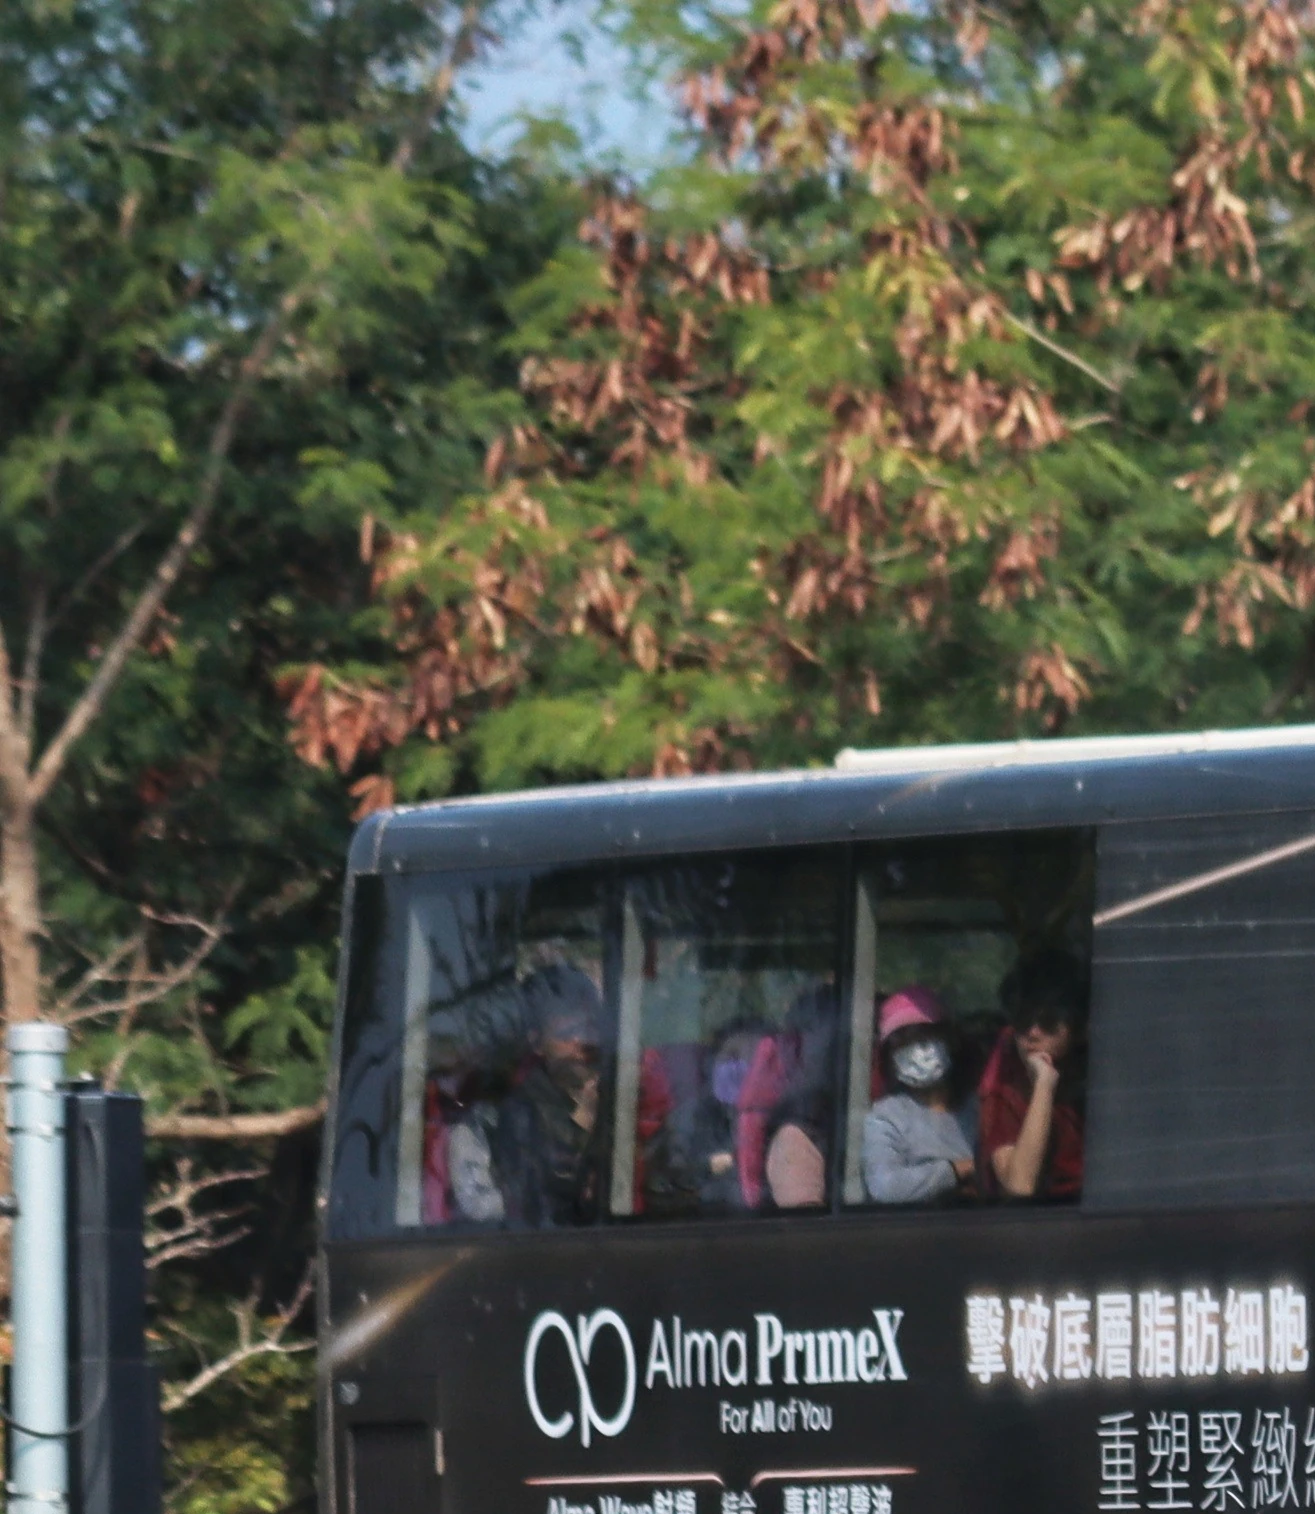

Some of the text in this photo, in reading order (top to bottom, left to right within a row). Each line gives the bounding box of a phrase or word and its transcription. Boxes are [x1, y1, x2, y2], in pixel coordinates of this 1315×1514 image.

[645, 1307, 908, 1390] Alma PrimeX
[965, 1284, 1309, 1389] 擊破底層脂肪細胞
[720, 1396, 833, 1434] For All of You
